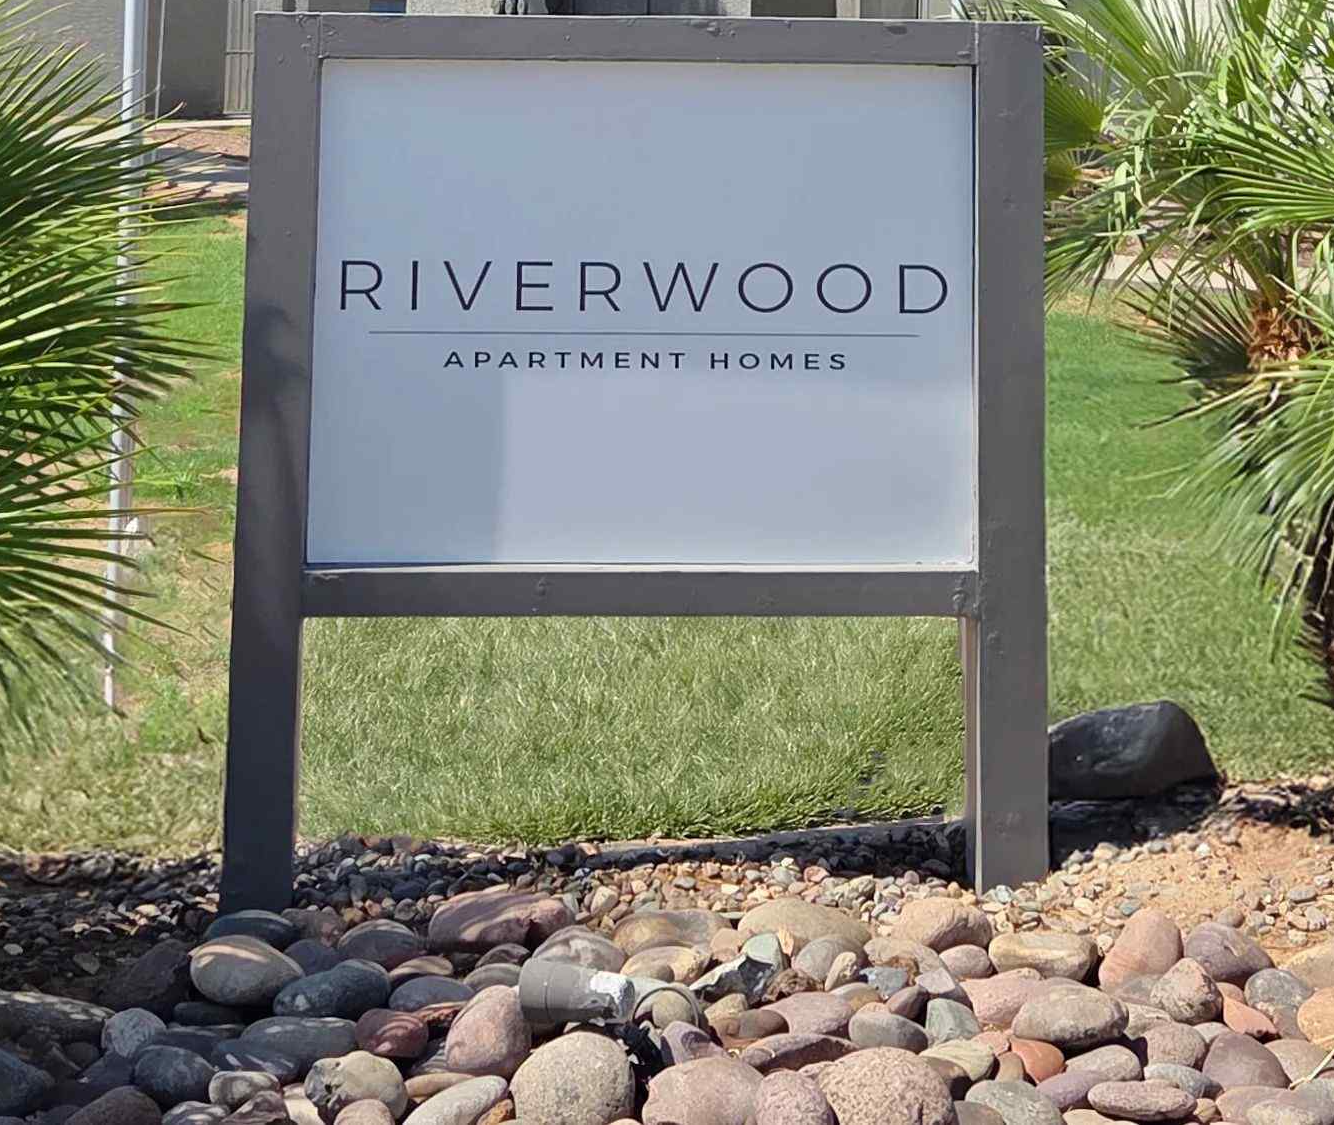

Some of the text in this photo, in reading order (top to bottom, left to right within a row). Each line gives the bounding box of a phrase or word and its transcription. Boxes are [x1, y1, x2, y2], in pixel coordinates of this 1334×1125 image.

[339, 260, 949, 315] RIVERWOOD
[443, 350, 847, 371] APARTMENT HOMES
